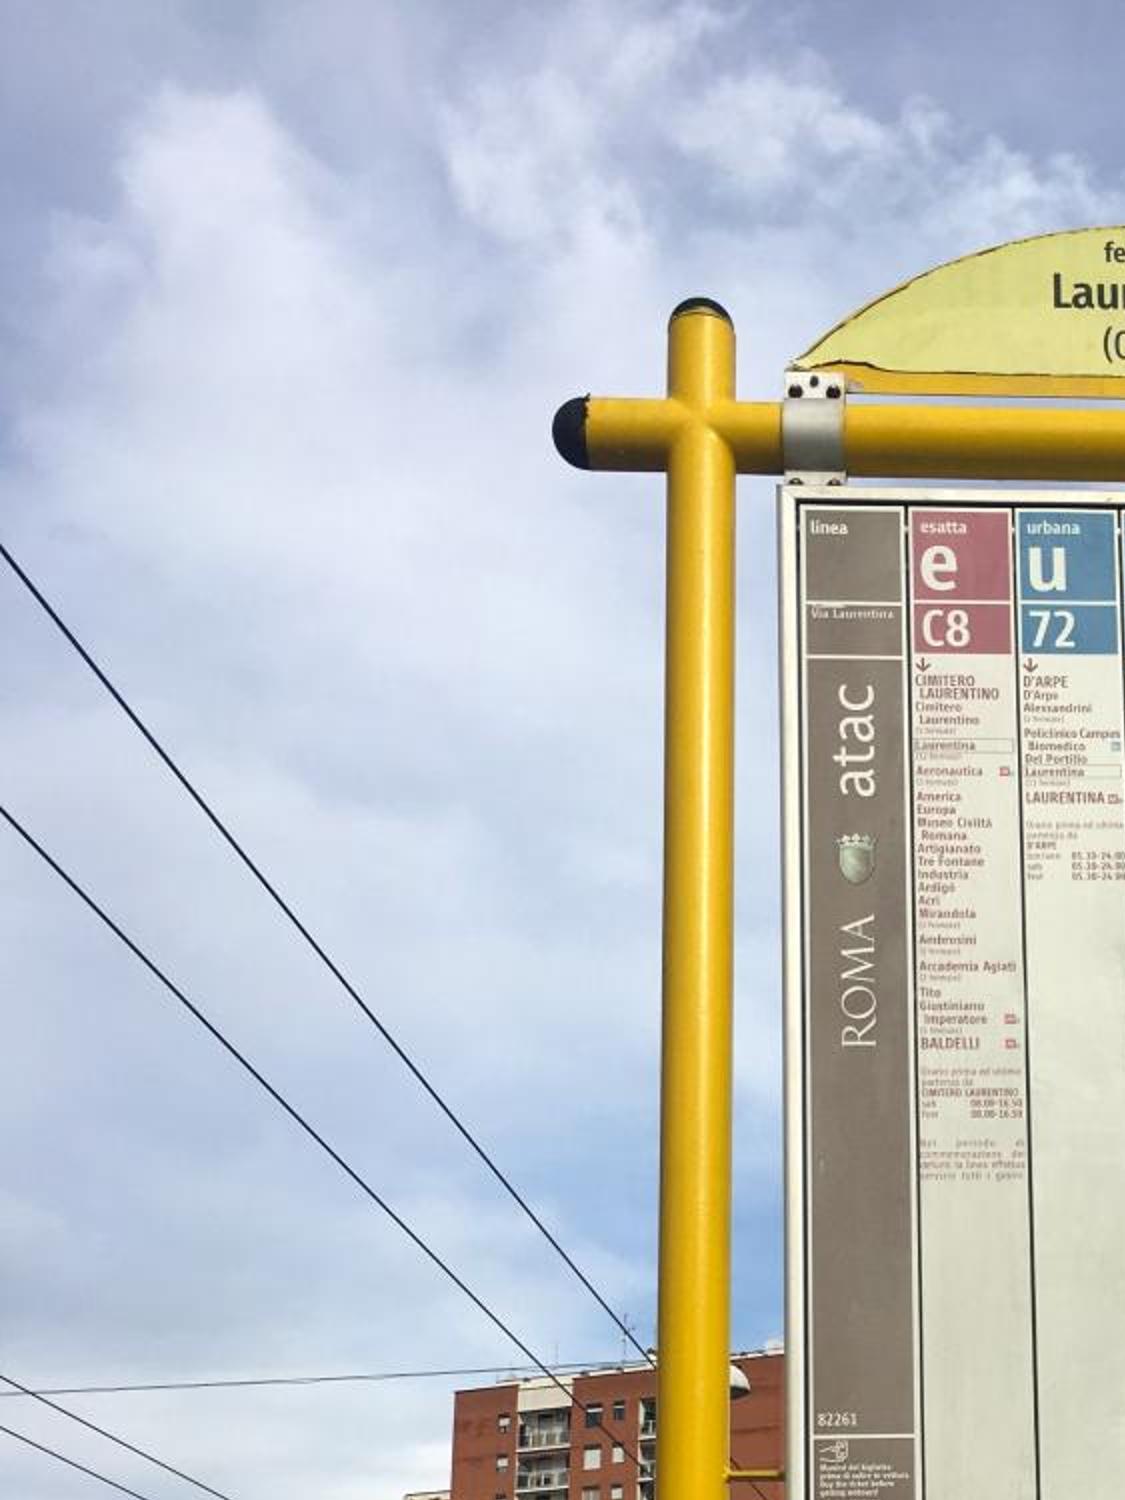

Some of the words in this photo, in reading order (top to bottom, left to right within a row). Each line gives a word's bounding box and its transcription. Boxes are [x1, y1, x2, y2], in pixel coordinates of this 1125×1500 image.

[810, 520, 848, 535] linea
[920, 521, 966, 534] esatta
[1028, 522, 1080, 535] urbana
[920, 545, 957, 590] e
[1029, 547, 1066, 591] u
[811, 608, 830, 619] Via
[922, 610, 970, 648] C8
[1029, 611, 1075, 648] 72
[915, 676, 975, 686] CIMITERO
[1024, 676, 1067, 687] D'ARPE
[920, 688, 999, 700] LAURENTINO
[916, 703, 962, 712] Cimitero
[1024, 704, 1091, 713] Alessandrini
[920, 716, 979, 724] Laurentino
[1025, 729, 1076, 738] Policlinico
[1080, 730, 1120, 740] Campus
[833, 685, 874, 797] atac
[915, 742, 975, 750] Laurentina
[917, 767, 983, 776] Aeronautica
[1026, 768, 1084, 777] Laurentina
[917, 793, 961, 801] America
[1027, 793, 1103, 804] LAURENTINA
[917, 806, 956, 816] Europa
[922, 832, 966, 840] Romana
[918, 845, 980, 854] Artigianato
[918, 858, 935, 866] Tre
[939, 858, 984, 866] Fontane
[918, 871, 968, 879] Industria
[920, 936, 976, 944] Ambrosini
[920, 962, 978, 971] Accademia
[842, 913, 877, 1048] ROMA
[920, 988, 941, 997] Tito
[920, 1002, 984, 1011] Giustiniano
[924, 1015, 987, 1026] Imperatore
[921, 1038, 980, 1049] BALDELLI
[817, 1413, 857, 1426] 82261
